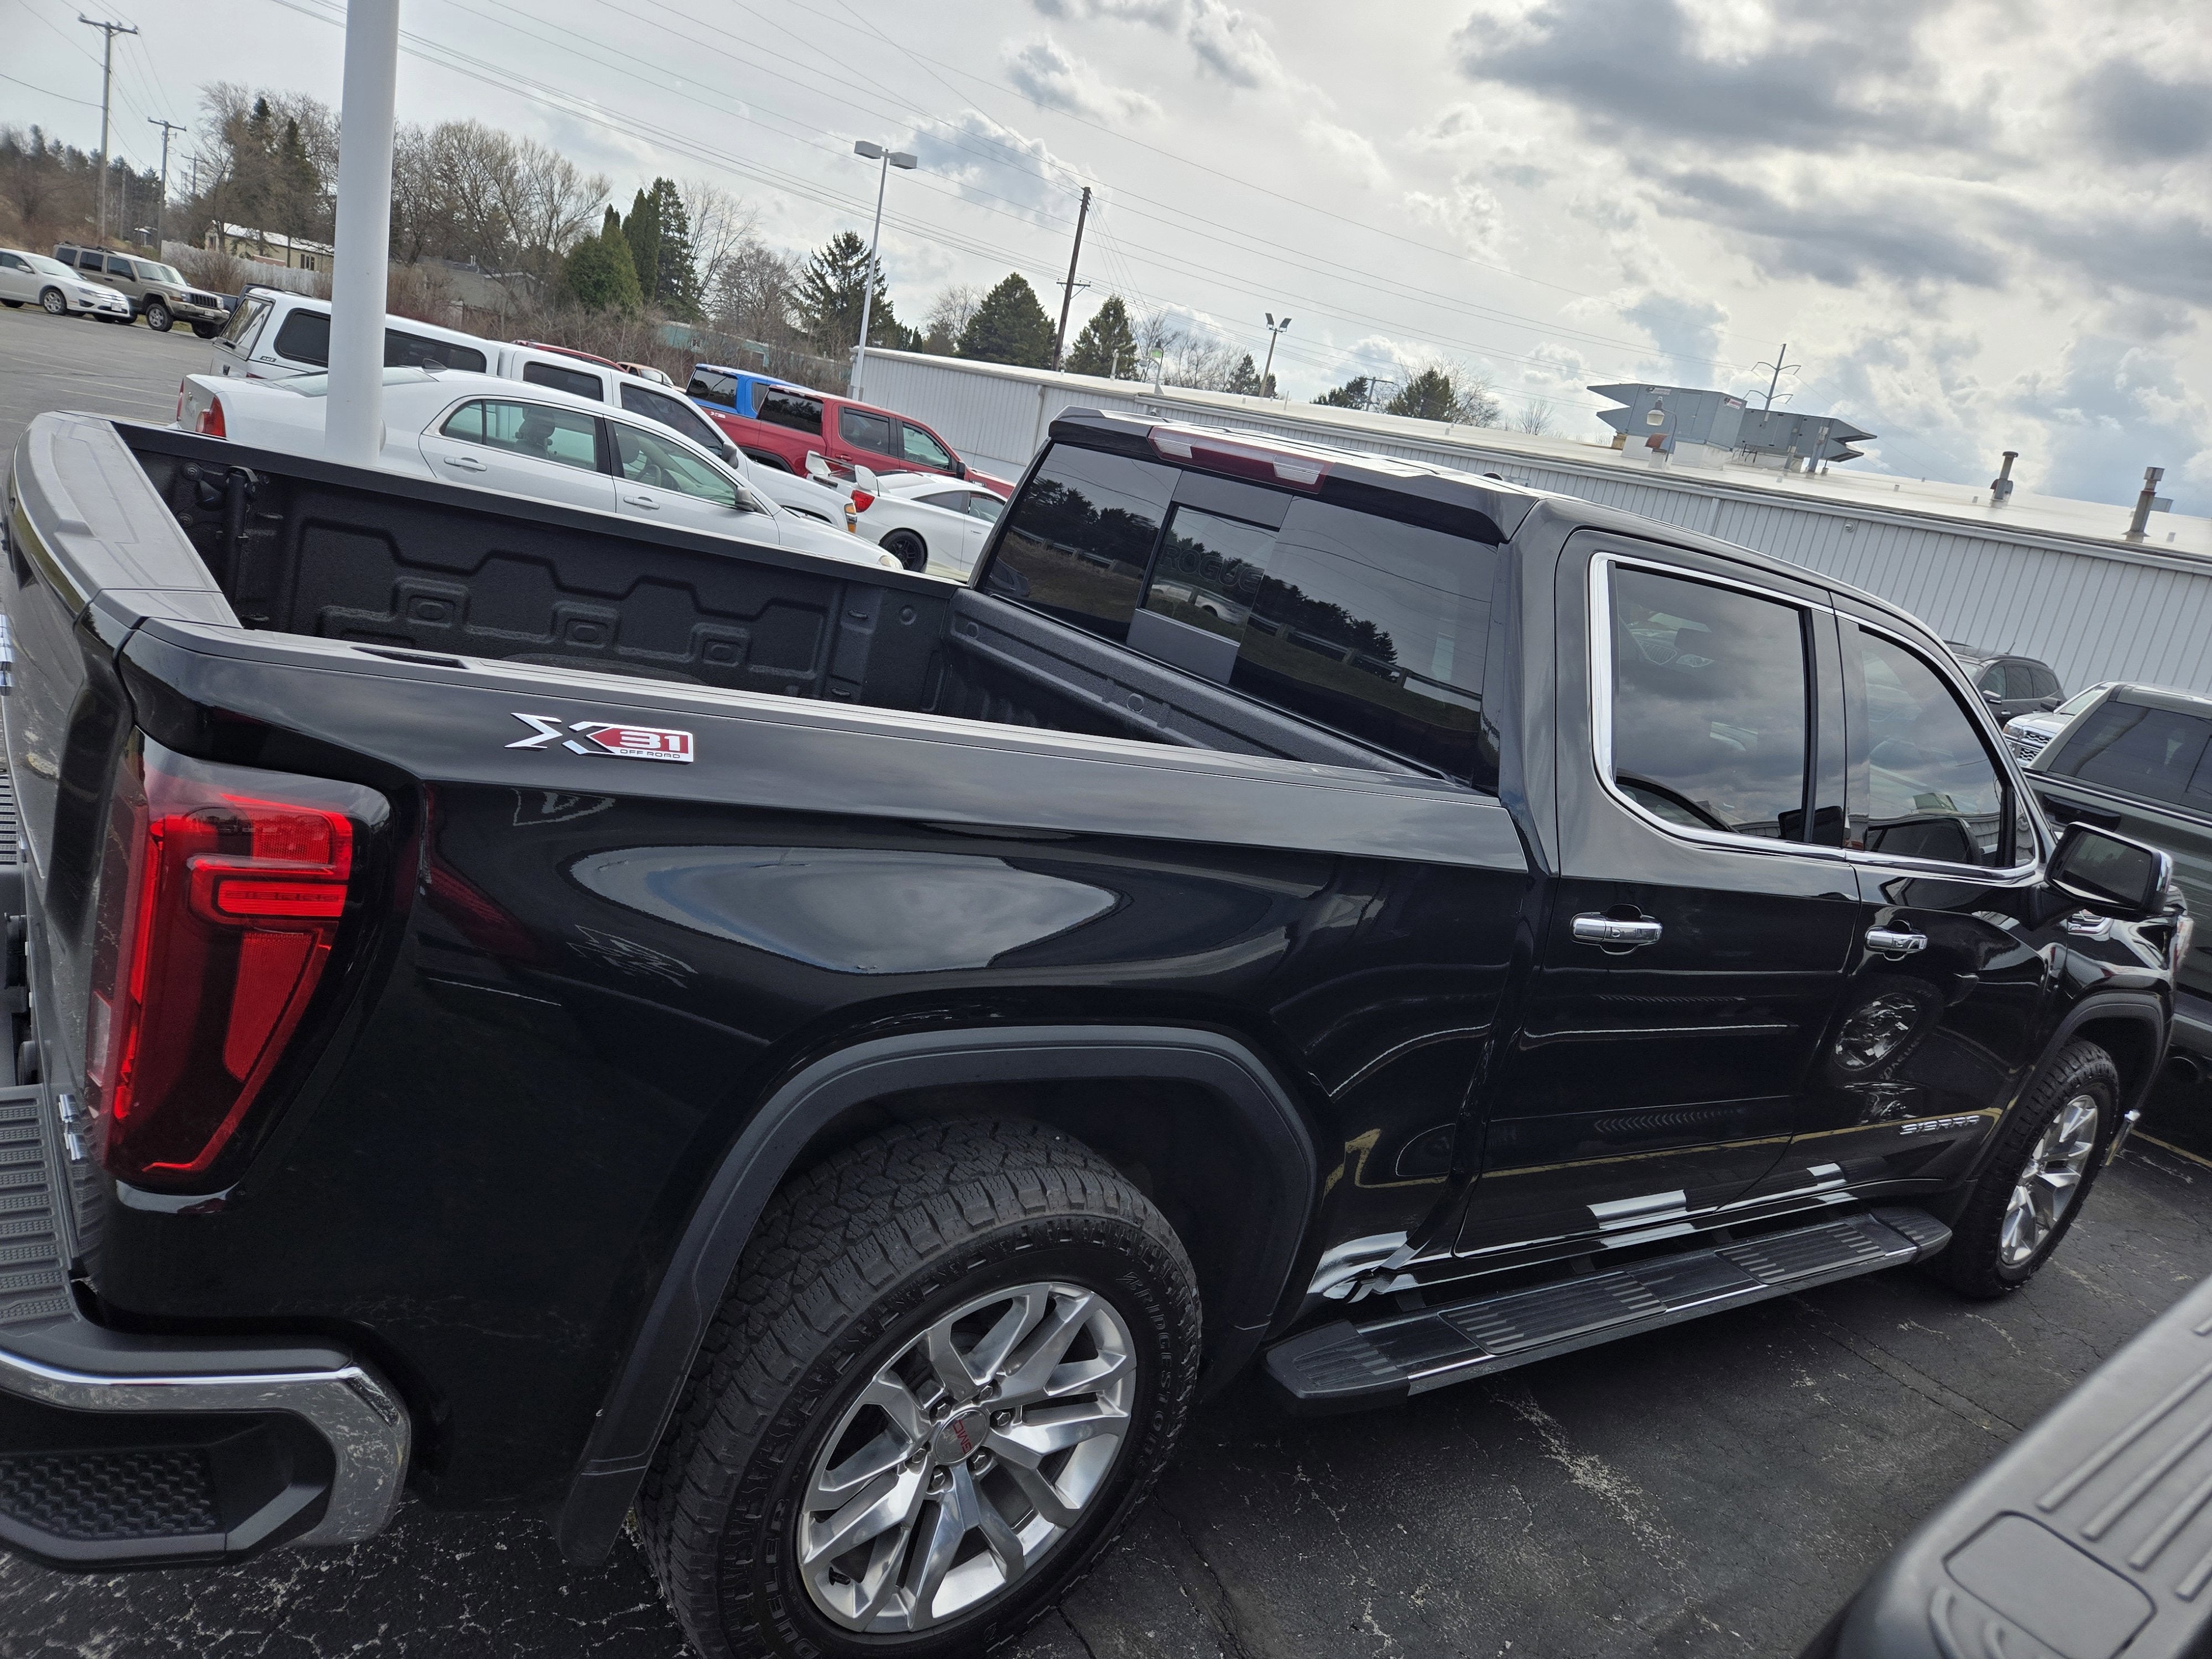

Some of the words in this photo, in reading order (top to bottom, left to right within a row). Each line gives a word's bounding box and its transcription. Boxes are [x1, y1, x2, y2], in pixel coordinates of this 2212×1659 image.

[1159, 542, 1265, 594] ROGUE
[504, 712, 688, 757] X31
[1899, 1115, 1979, 1135] SIERRA
[952, 1418, 972, 1454] GMC
[764, 1498, 822, 1659] DUELER
